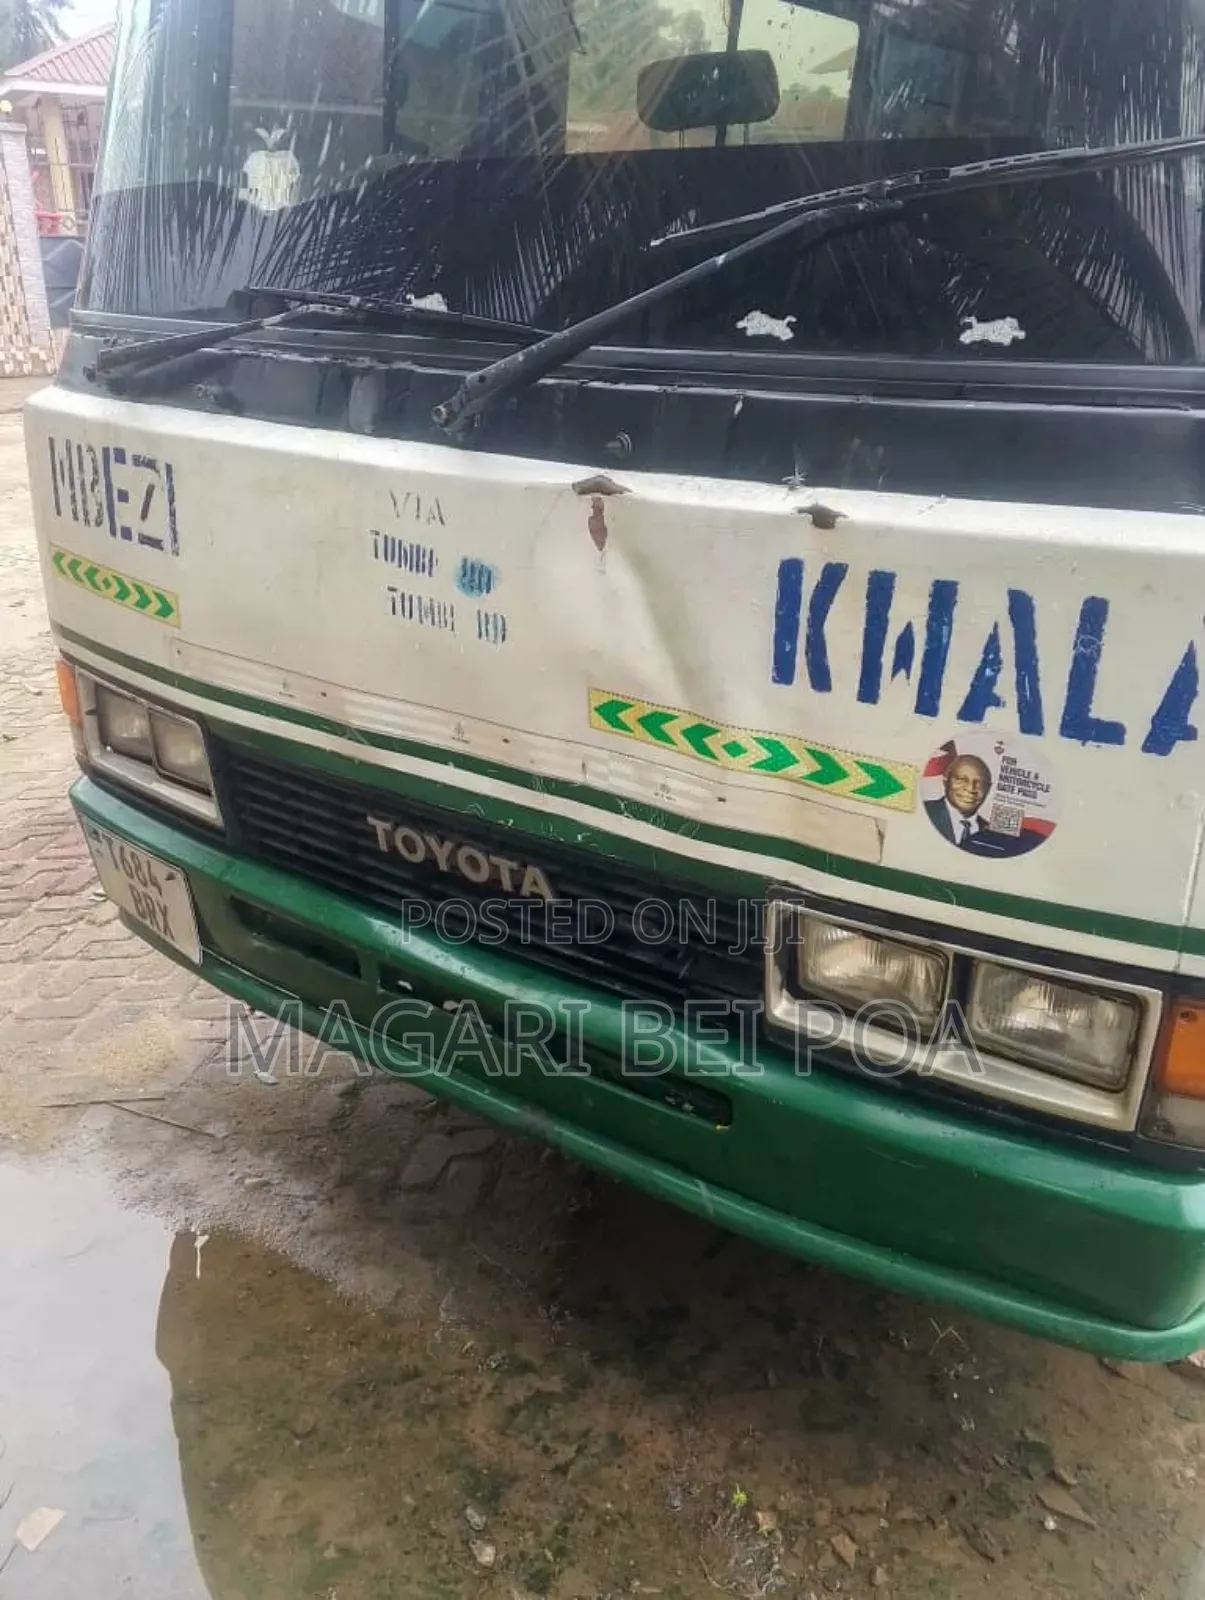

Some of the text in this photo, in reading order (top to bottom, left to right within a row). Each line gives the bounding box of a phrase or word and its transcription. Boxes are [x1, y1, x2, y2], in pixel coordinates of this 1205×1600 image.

[48, 436, 180, 556] MBEZI
[389, 489, 446, 526] VIA
[366, 814, 555, 903] TOYOTA
